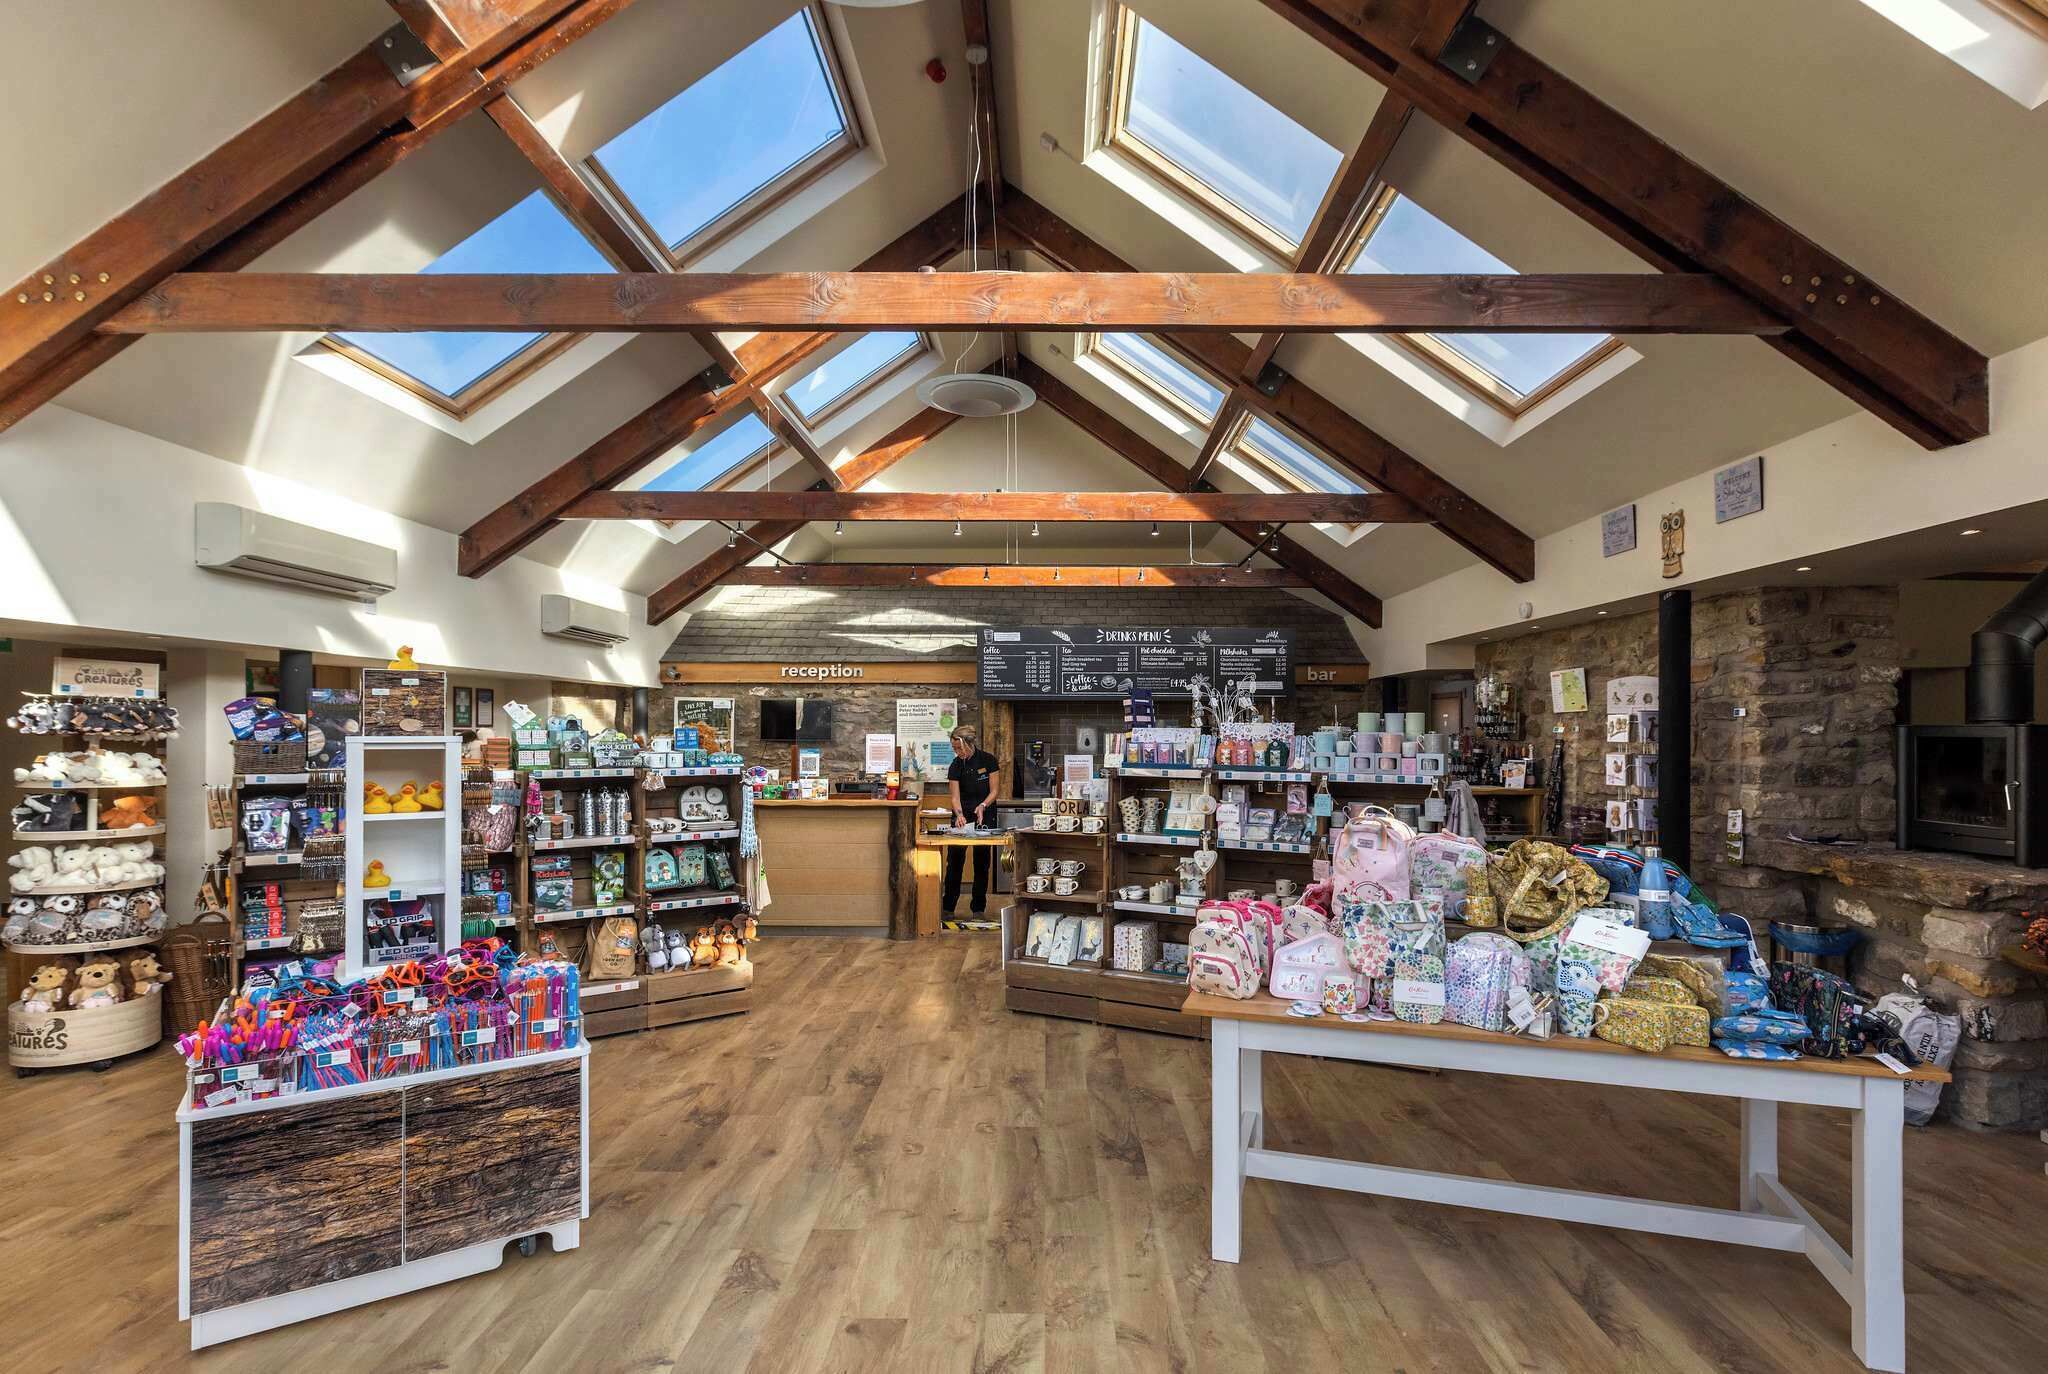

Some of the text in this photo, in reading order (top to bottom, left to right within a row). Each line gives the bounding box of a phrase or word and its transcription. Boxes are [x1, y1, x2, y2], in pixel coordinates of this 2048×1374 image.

[1105, 631, 1162, 642] DRINKS MENU
[983, 646, 1001, 655] Coffee
[1061, 646, 1072, 654] Tea
[1150, 646, 1177, 655] chocolate
[781, 663, 864, 681] reception
[1307, 665, 1336, 681] bar
[1070, 674, 1092, 685] Coffee
[1170, 678, 1187, 688] £4.95
[1078, 683, 1093, 691] cake
[1058, 800, 1090, 815] ORLA
[375, 914, 425, 927] LED GRIP
[378, 945, 430, 956] LED GRIP
[1918, 1033, 1933, 1055] KIND
